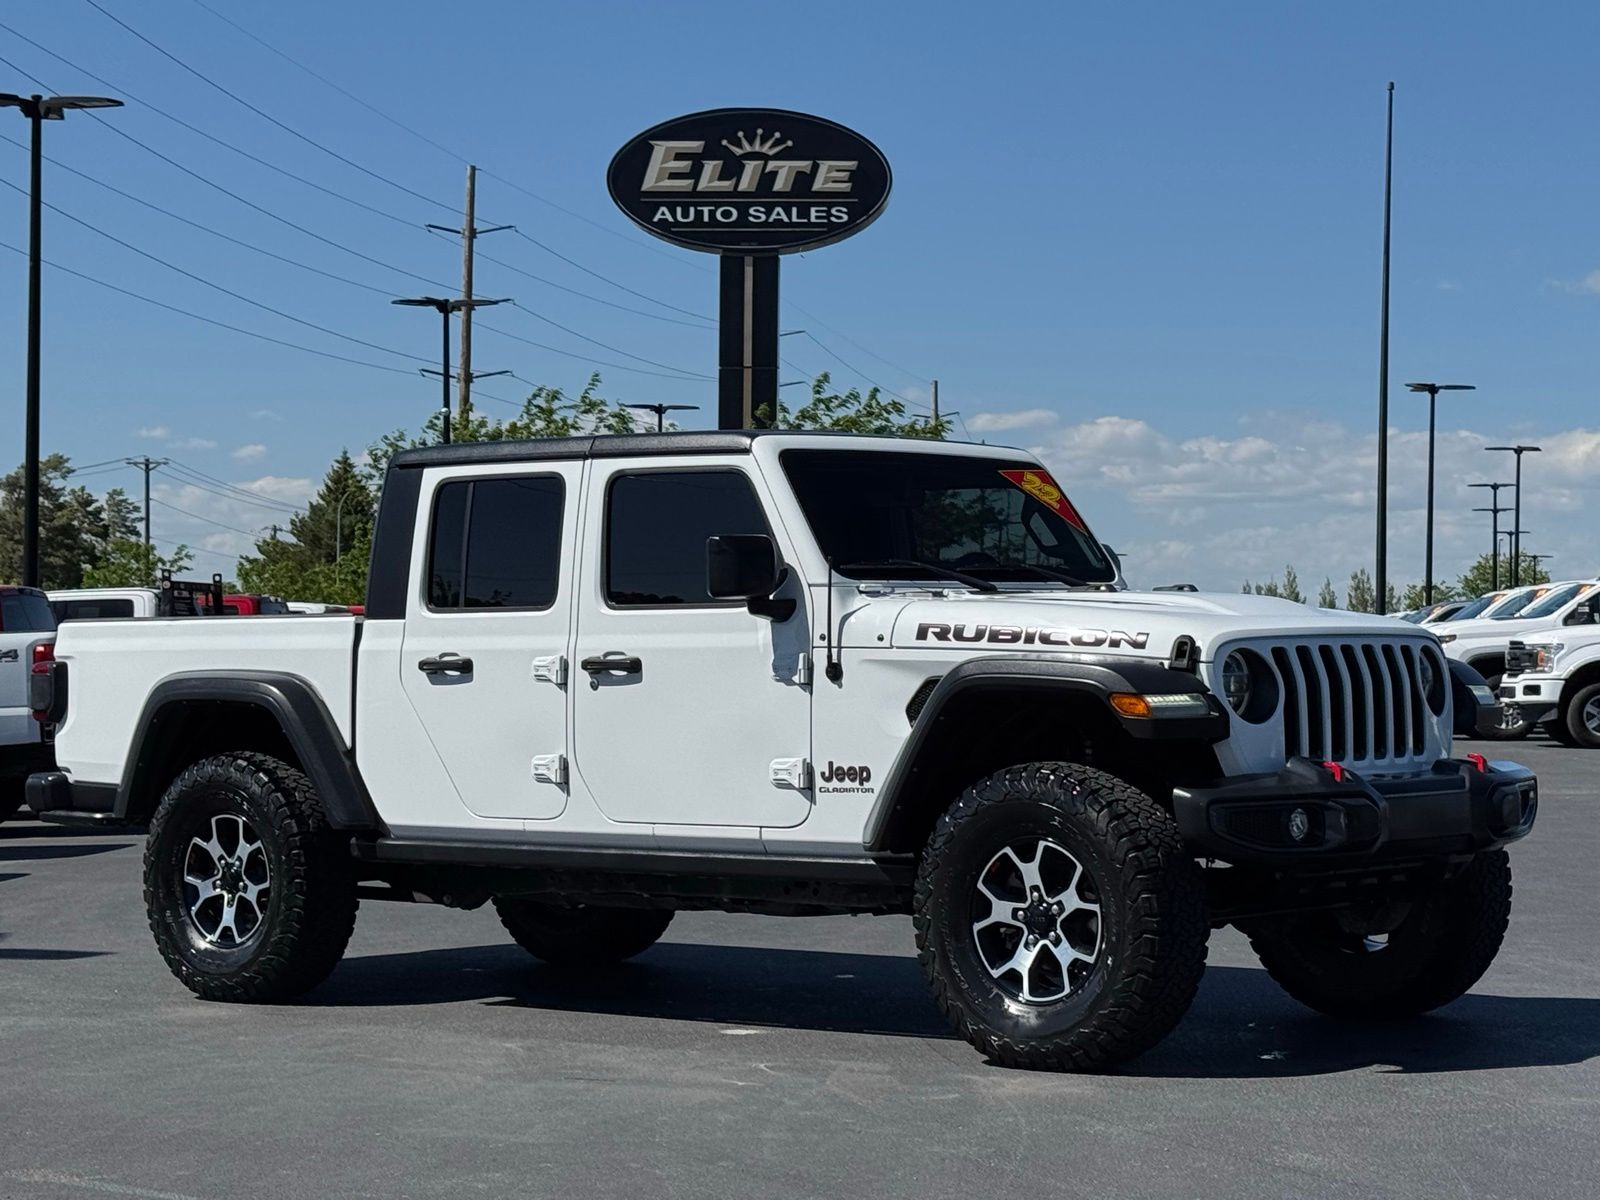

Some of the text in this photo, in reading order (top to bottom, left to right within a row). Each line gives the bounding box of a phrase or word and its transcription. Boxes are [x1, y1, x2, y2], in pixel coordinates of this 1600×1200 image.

[640, 140, 859, 192] ELITE
[652, 206, 849, 223] AUTO SALES
[915, 622, 1150, 650] RUBICON
[820, 761, 871, 786] Jeep
